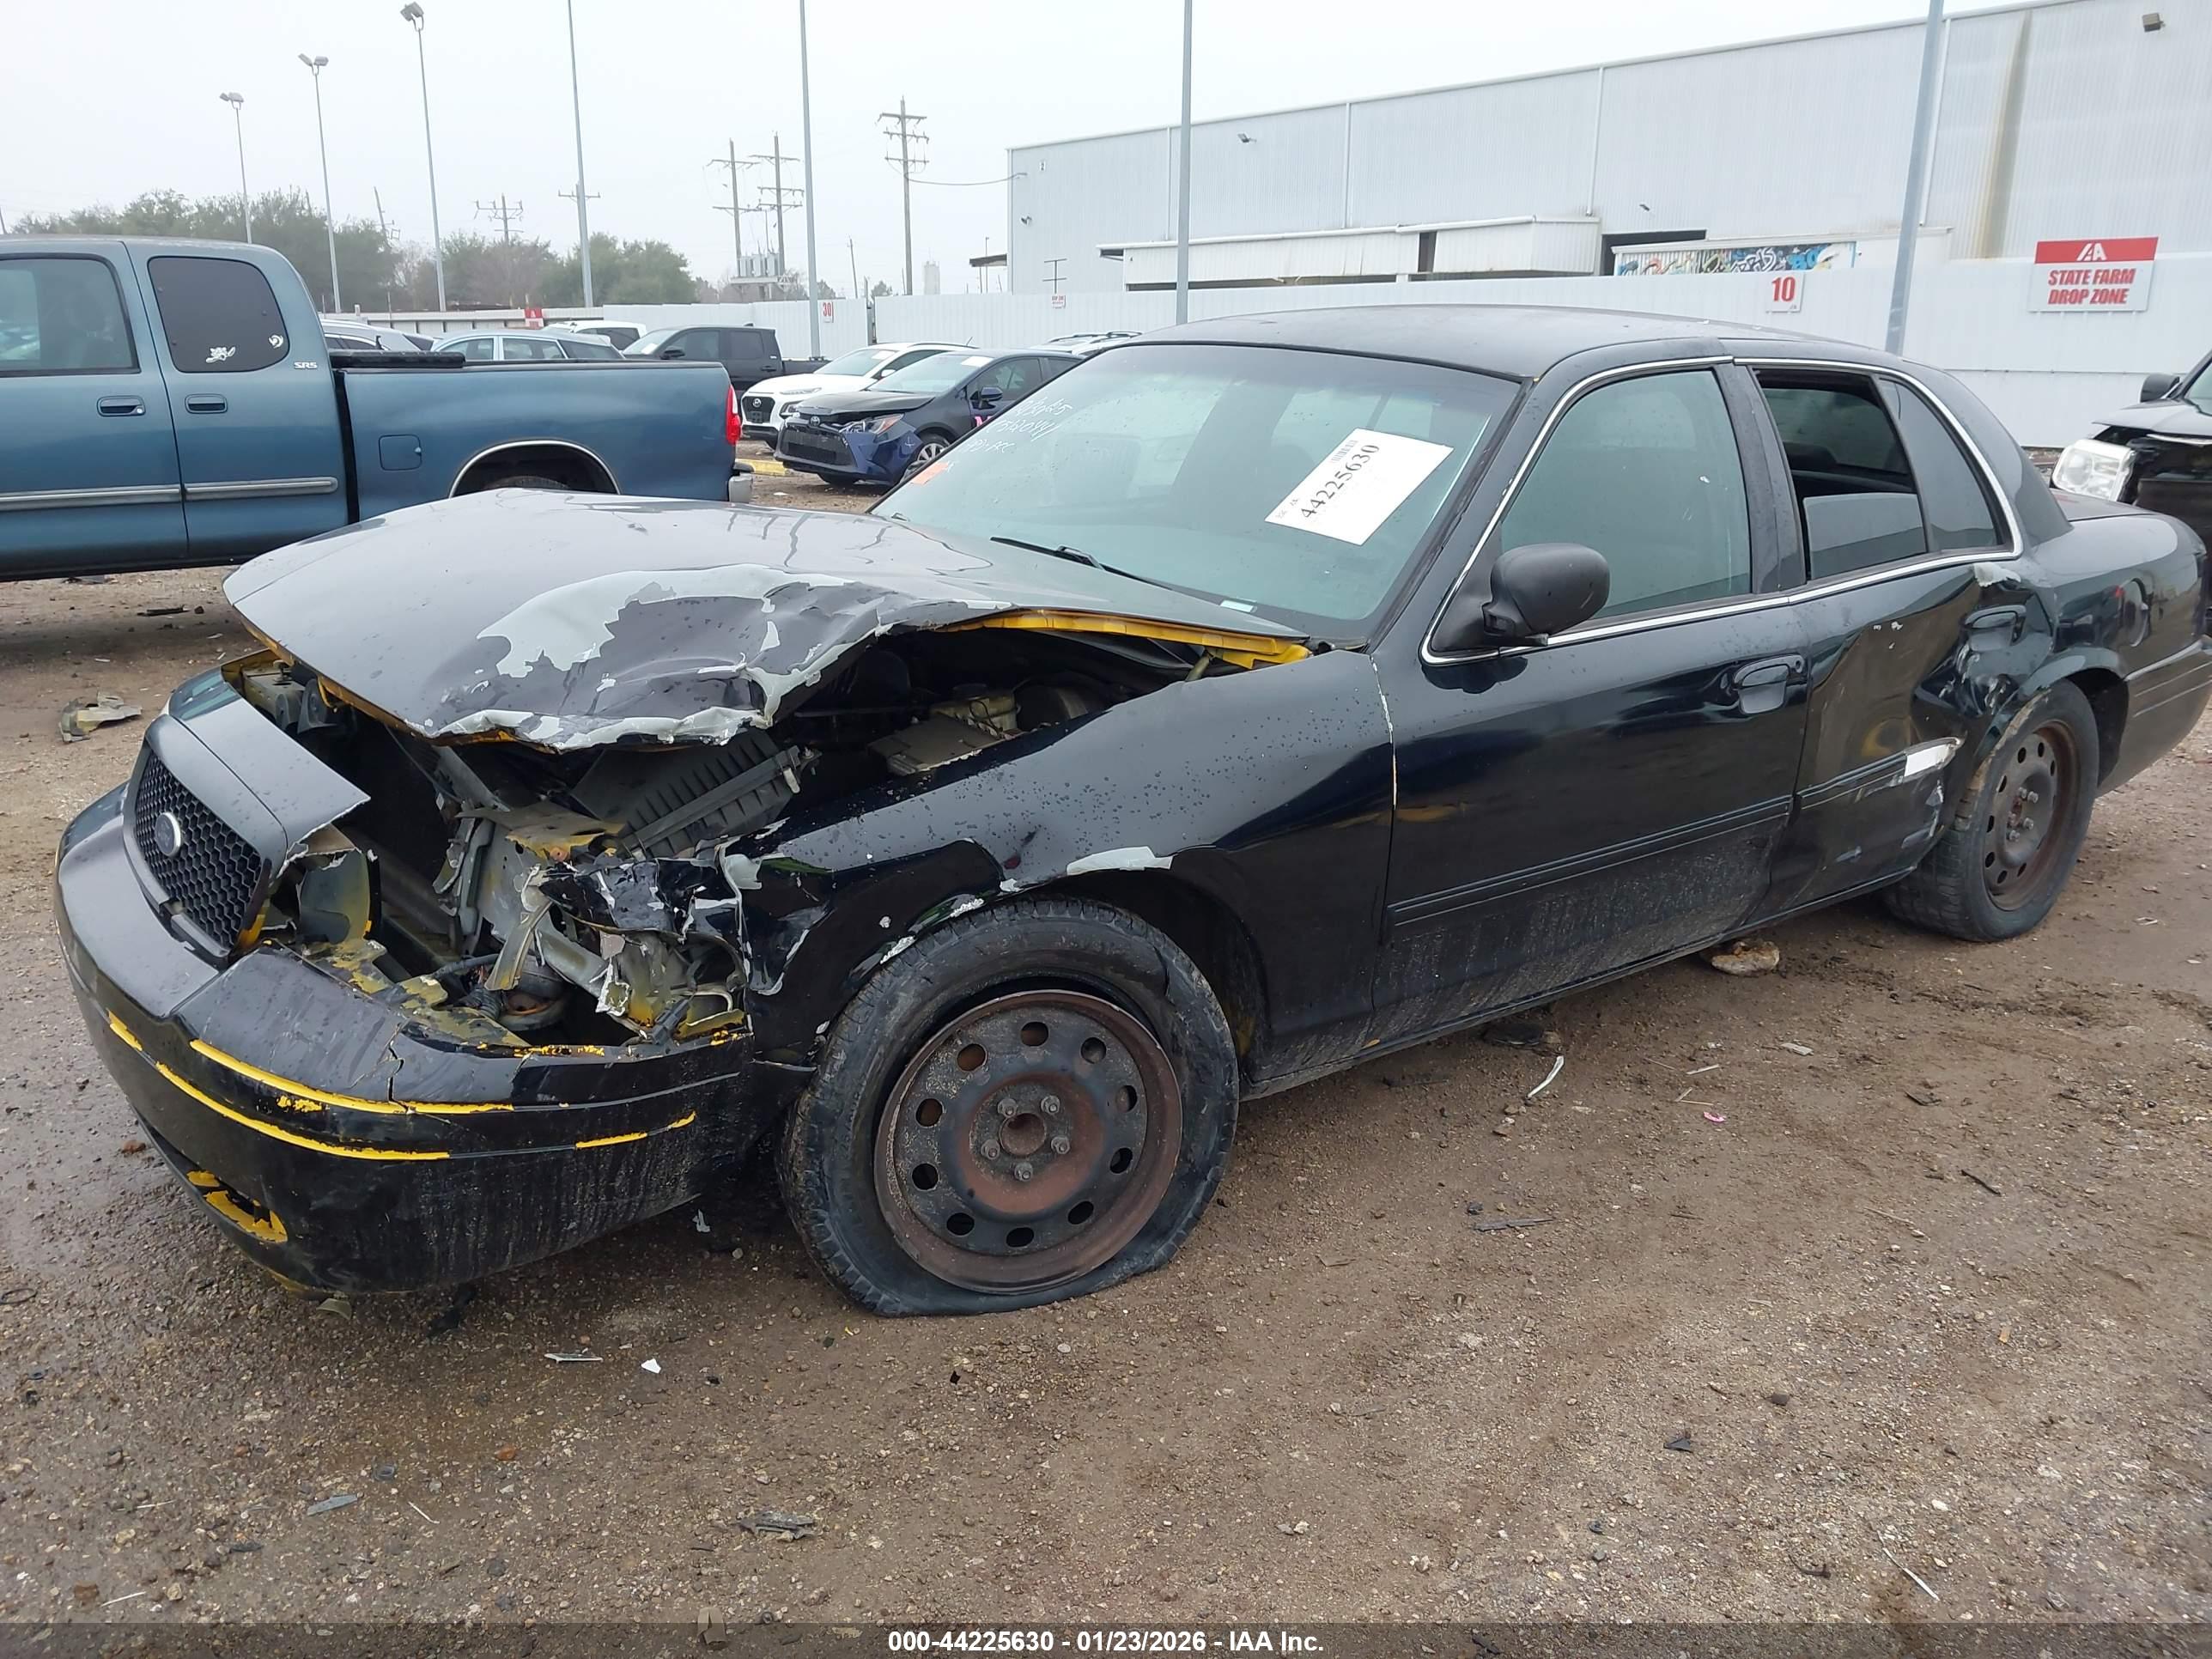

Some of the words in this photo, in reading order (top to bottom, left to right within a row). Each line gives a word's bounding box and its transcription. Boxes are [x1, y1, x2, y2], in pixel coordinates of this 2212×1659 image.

[2047, 269, 2091, 286] STATE
[2092, 267, 2136, 285] FARM
[1771, 276, 1797, 302] 10
[2047, 289, 2090, 305] DROP
[2089, 288, 2130, 305] ZONE
[823, 301, 832, 317] 30
[294, 361, 318, 369] SR5
[1301, 445, 1380, 518] 44225630
